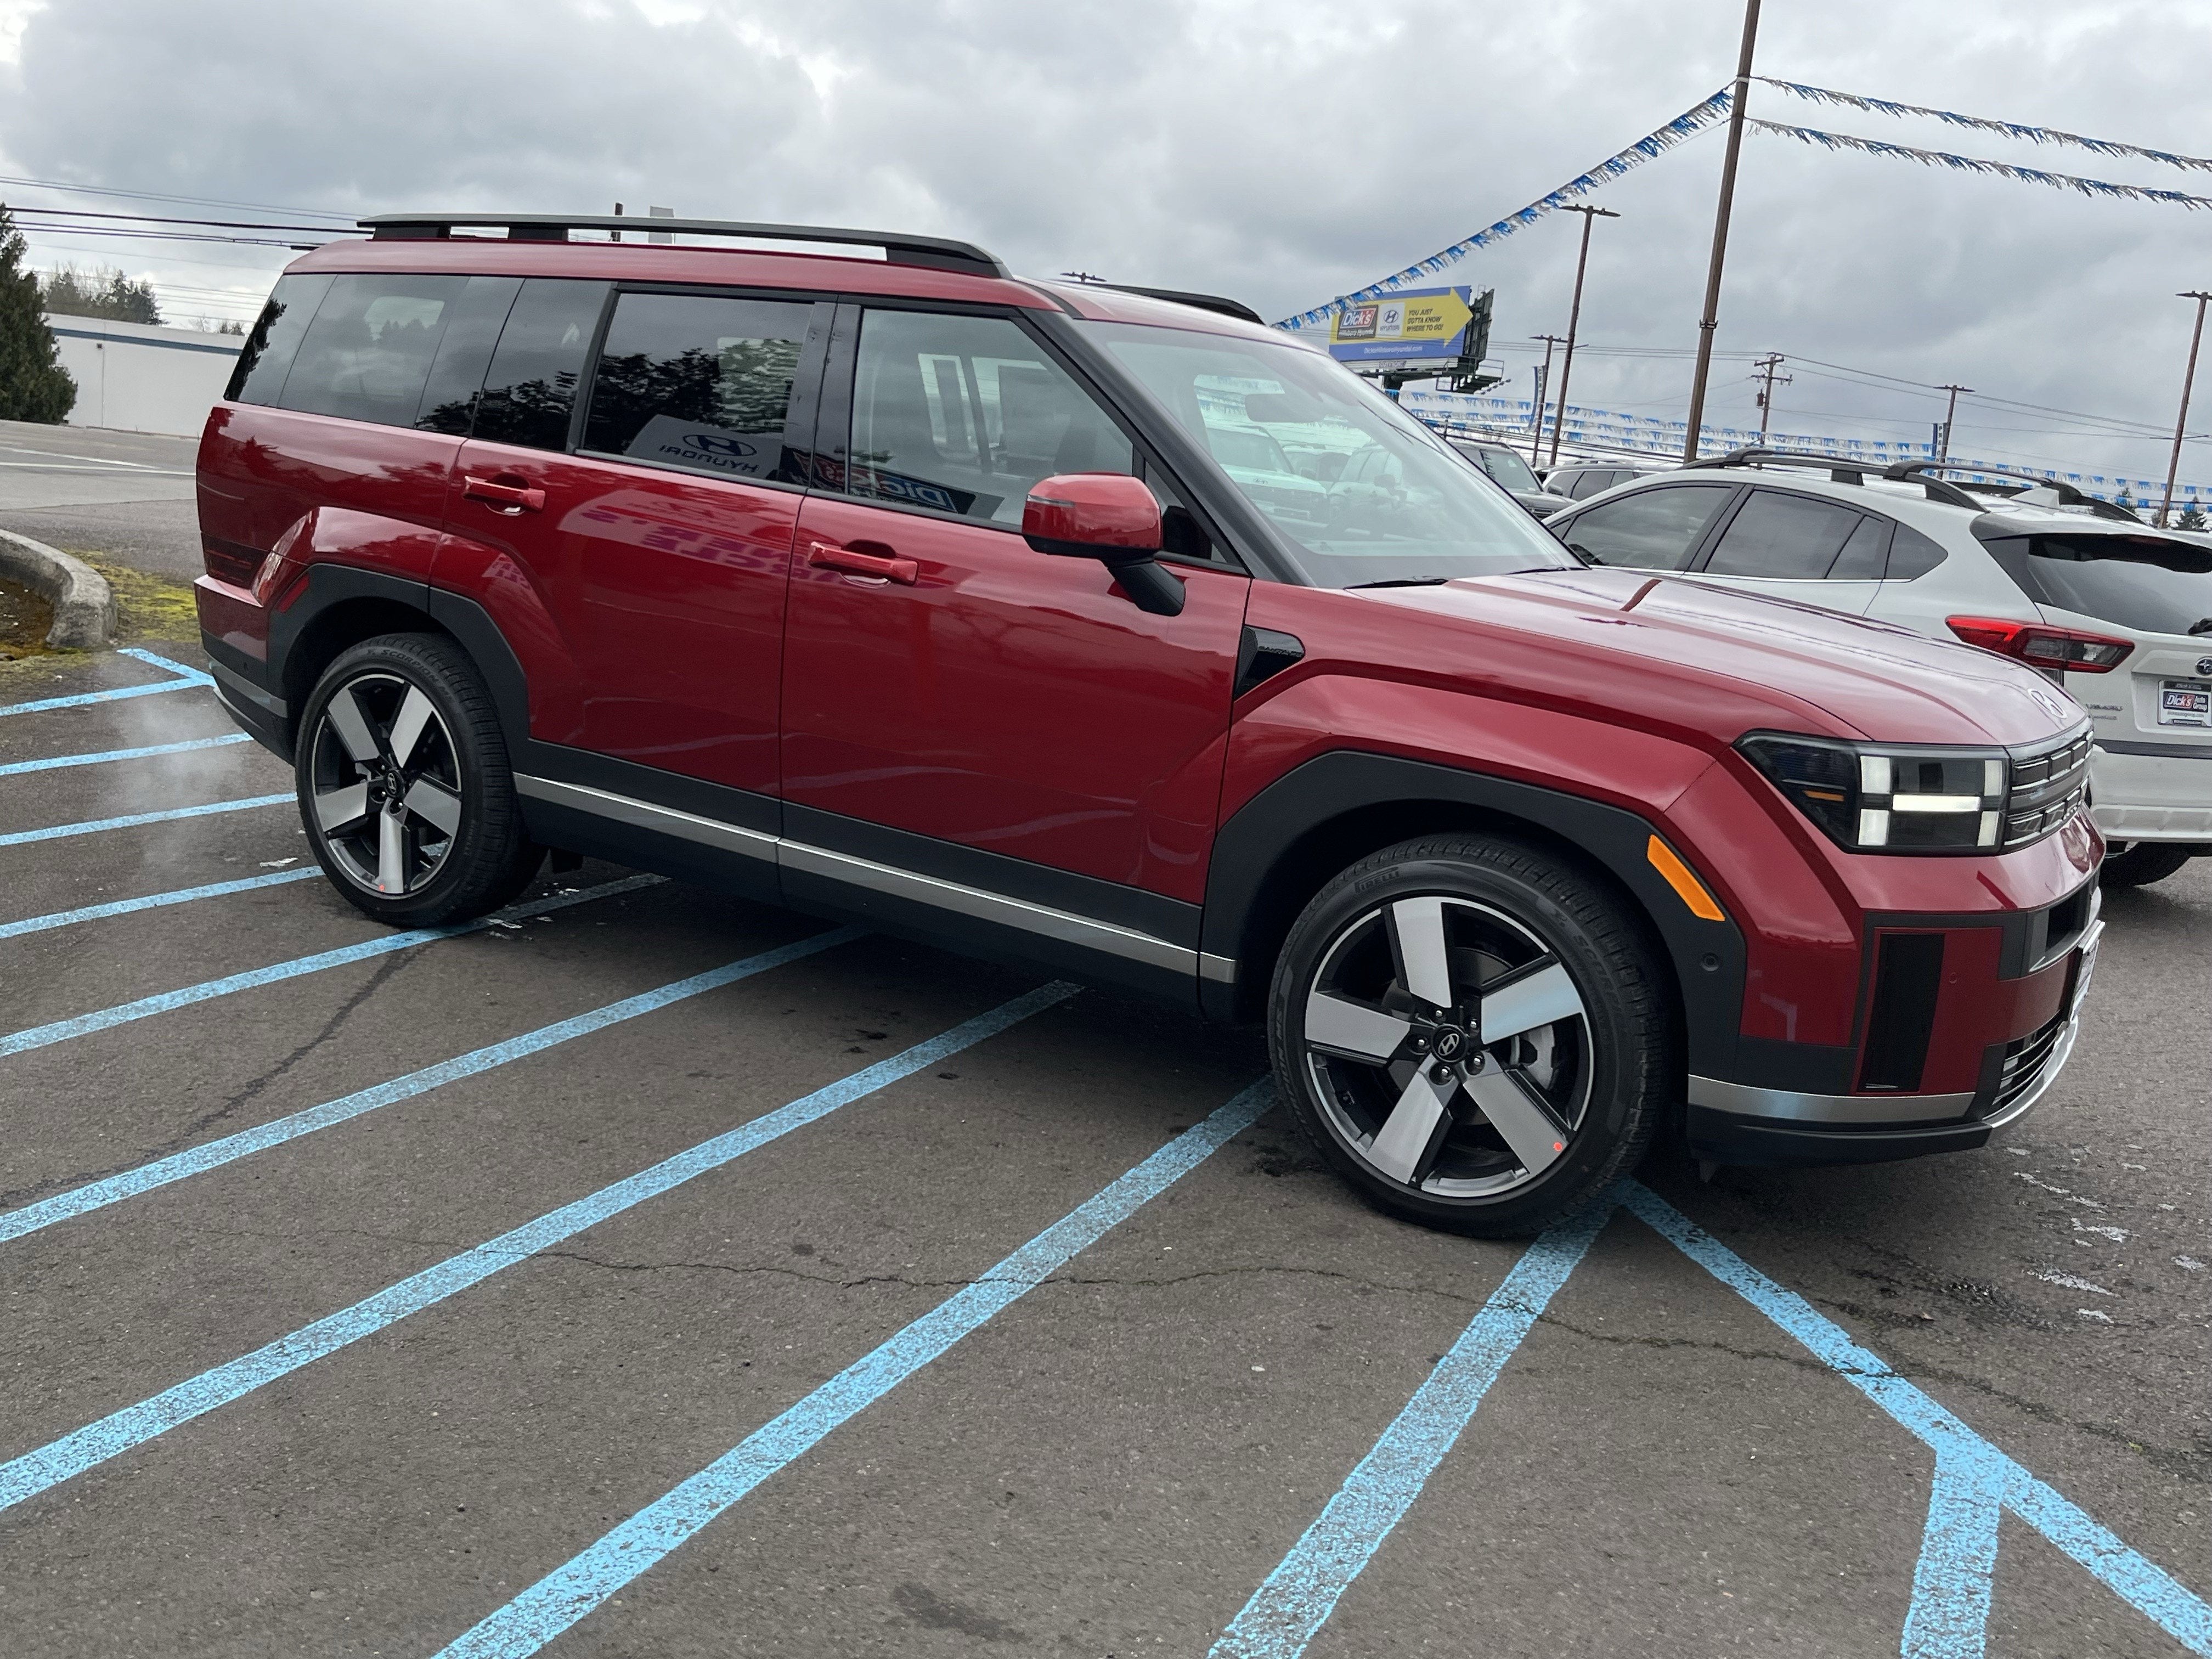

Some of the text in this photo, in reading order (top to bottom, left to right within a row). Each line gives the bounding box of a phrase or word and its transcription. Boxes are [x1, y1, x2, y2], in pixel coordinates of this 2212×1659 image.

[1343, 311, 1372, 326] Dick's
[2166, 695, 2192, 707] Dick's
[1354, 867, 1400, 895] PIRELLI
